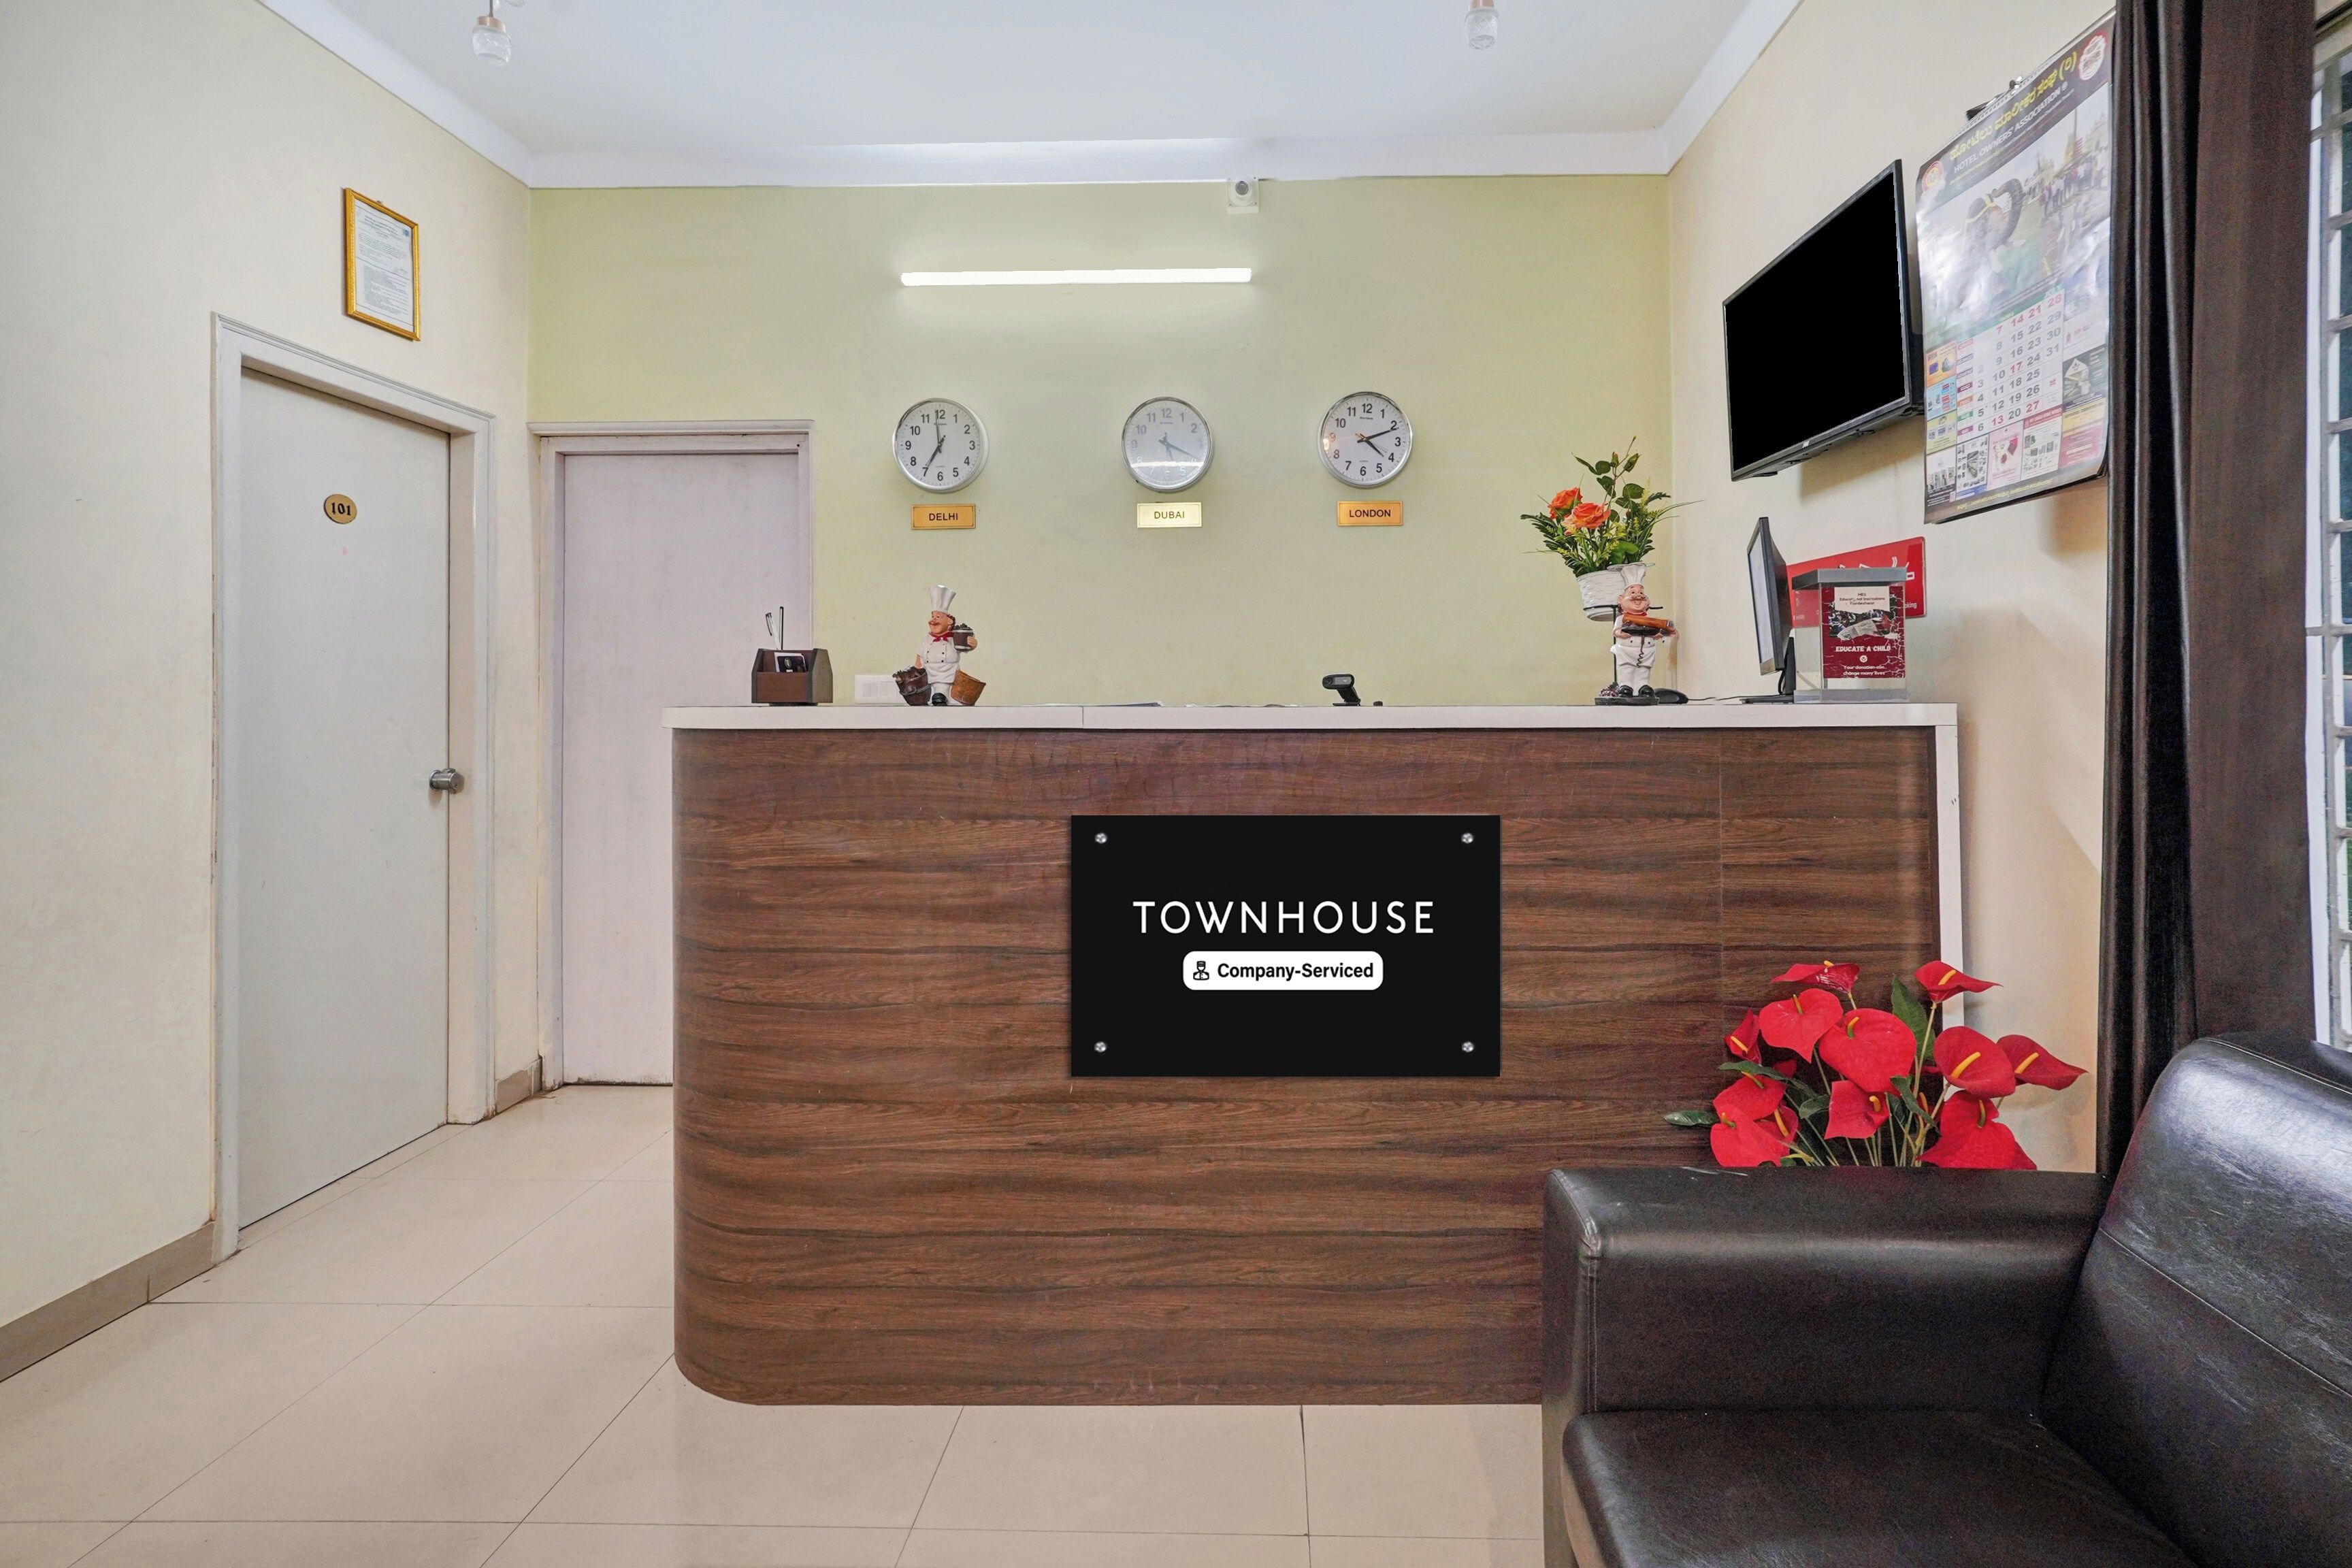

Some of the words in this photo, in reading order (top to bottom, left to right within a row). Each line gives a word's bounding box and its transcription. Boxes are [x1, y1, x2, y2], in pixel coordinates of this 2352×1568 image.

[1954, 152, 1978, 173] HOTEL
[2014, 86, 2061, 131] ASSOCIATION
[1996, 325, 2003, 334] 7
[2011, 314, 2024, 327] 14
[2028, 305, 2041, 319] 21
[2048, 294, 2062, 308] 28
[1996, 342, 2002, 350] 8
[2011, 330, 2023, 342] 15
[2028, 321, 2042, 334] 22
[2047, 311, 2061, 325] 29
[1996, 357, 2002, 365] 9
[2010, 346, 2023, 358] 16
[2028, 337, 2041, 350] 23
[2047, 327, 2061, 340] 30
[1978, 379, 1984, 388] 3
[1993, 370, 2005, 381] 10
[2010, 361, 2023, 373] 17
[2027, 353, 2040, 366] 24
[2046, 344, 2059, 357] 31
[1978, 394, 1984, 402] 4
[1993, 385, 2004, 396] 11
[2010, 377, 2022, 389] 18
[2027, 369, 2040, 382] 25
[1978, 408, 1984, 417] 5
[1993, 400, 2004, 411] 12
[2009, 393, 2022, 404] 19
[2026, 385, 2040, 397] 26
[1161, 408, 1172, 418] 12
[1347, 407, 1356, 416] 11
[1362, 404, 1372, 413] 12
[935, 410, 945, 419] 12
[1147, 413, 1155, 422] 11
[1180, 412, 1184, 422] 1
[1381, 409, 1384, 418] 1
[1978, 423, 1984, 431] 6
[1992, 415, 2004, 426] 13
[2008, 408, 2021, 420] 20
[2026, 400, 2040, 413] 27
[921, 414, 930, 423] 11
[953, 414, 958, 423] 1
[1335, 418, 1345, 428] 10
[964, 425, 970, 434] 2
[1136, 425, 1147, 434] 10
[1191, 423, 1197, 433] 2
[1391, 421, 1397, 430] 2
[910, 426, 920, 435] 10
[1330, 432, 1336, 442] 9
[1395, 437, 1401, 446] 3
[905, 441, 911, 450] 9
[970, 441, 975, 450] 3
[1334, 449, 1339, 459] 8
[1388, 452, 1394, 462] 4
[911, 457, 916, 466] 8
[964, 456, 970, 465] 4
[1345, 461, 1351, 470] 7
[1376, 463, 1382, 472] 5
[923, 467, 928, 476] 7
[953, 468, 959, 477] 5
[1180, 467, 1185, 476] 5
[1360, 466, 1366, 476] 6
[937, 472, 943, 481] 6
[331, 502, 351, 516] 101
[1349, 509, 1391, 518] LONDON
[929, 512, 958, 521] DELHI
[1132, 900, 1434, 934] TOWNHOUSE
[1218, 962, 1373, 981] Company-Serviced
